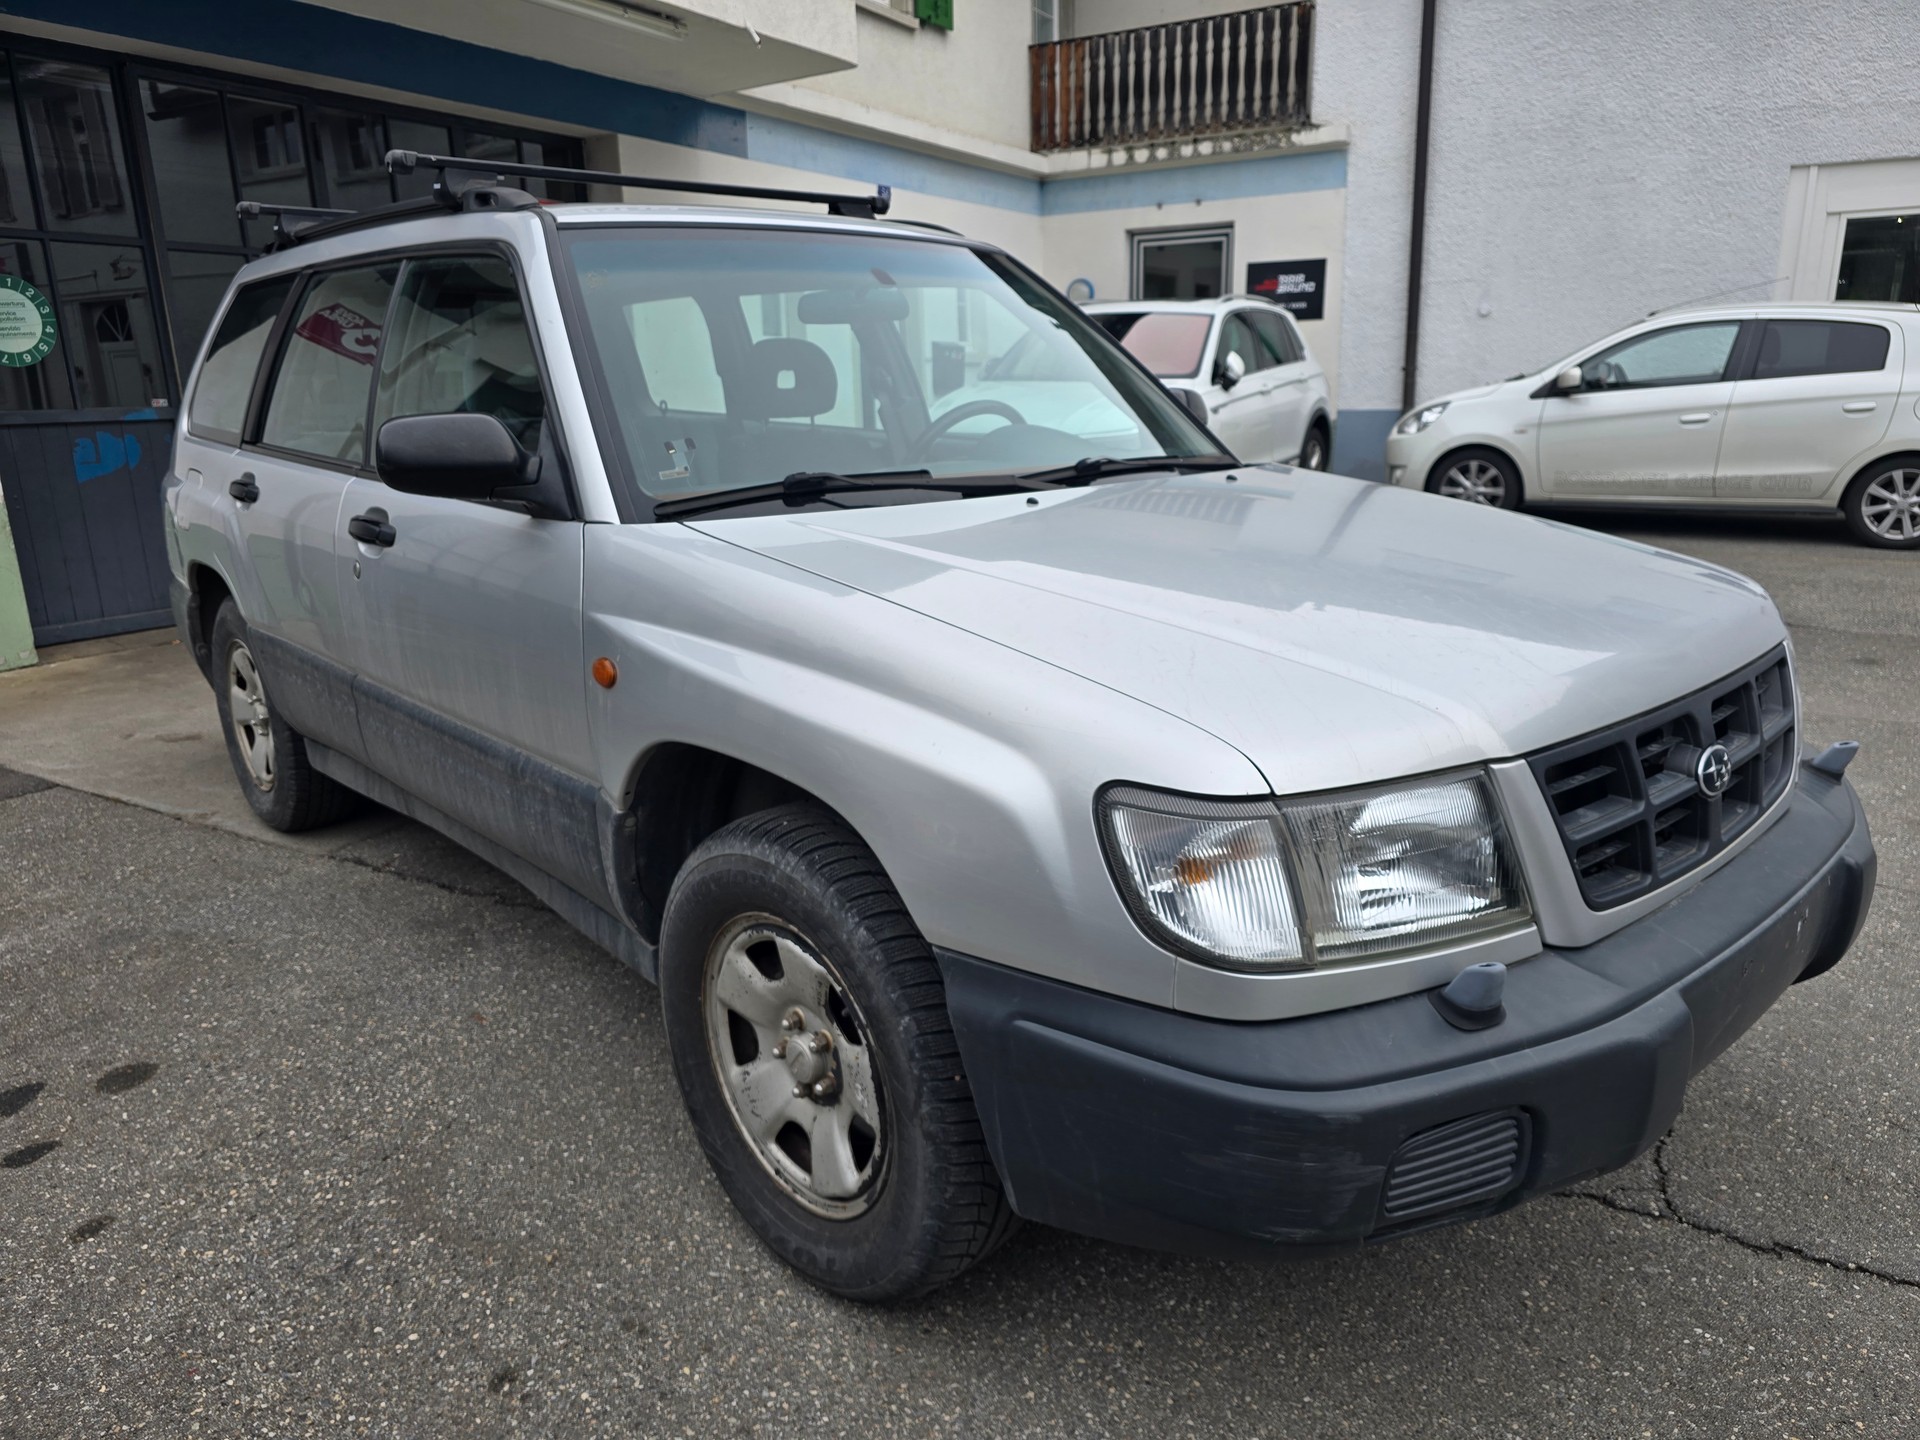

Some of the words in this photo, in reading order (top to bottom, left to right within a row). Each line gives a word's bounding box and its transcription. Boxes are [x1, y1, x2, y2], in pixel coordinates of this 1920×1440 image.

[6, 278, 11, 287] 1
[25, 288, 35, 297] 2
[40, 305, 50, 314] 3
[45, 325, 55, 333] 4
[39, 342, 48, 352] 5
[1, 354, 9, 363] 7
[23, 353, 32, 363] 6
